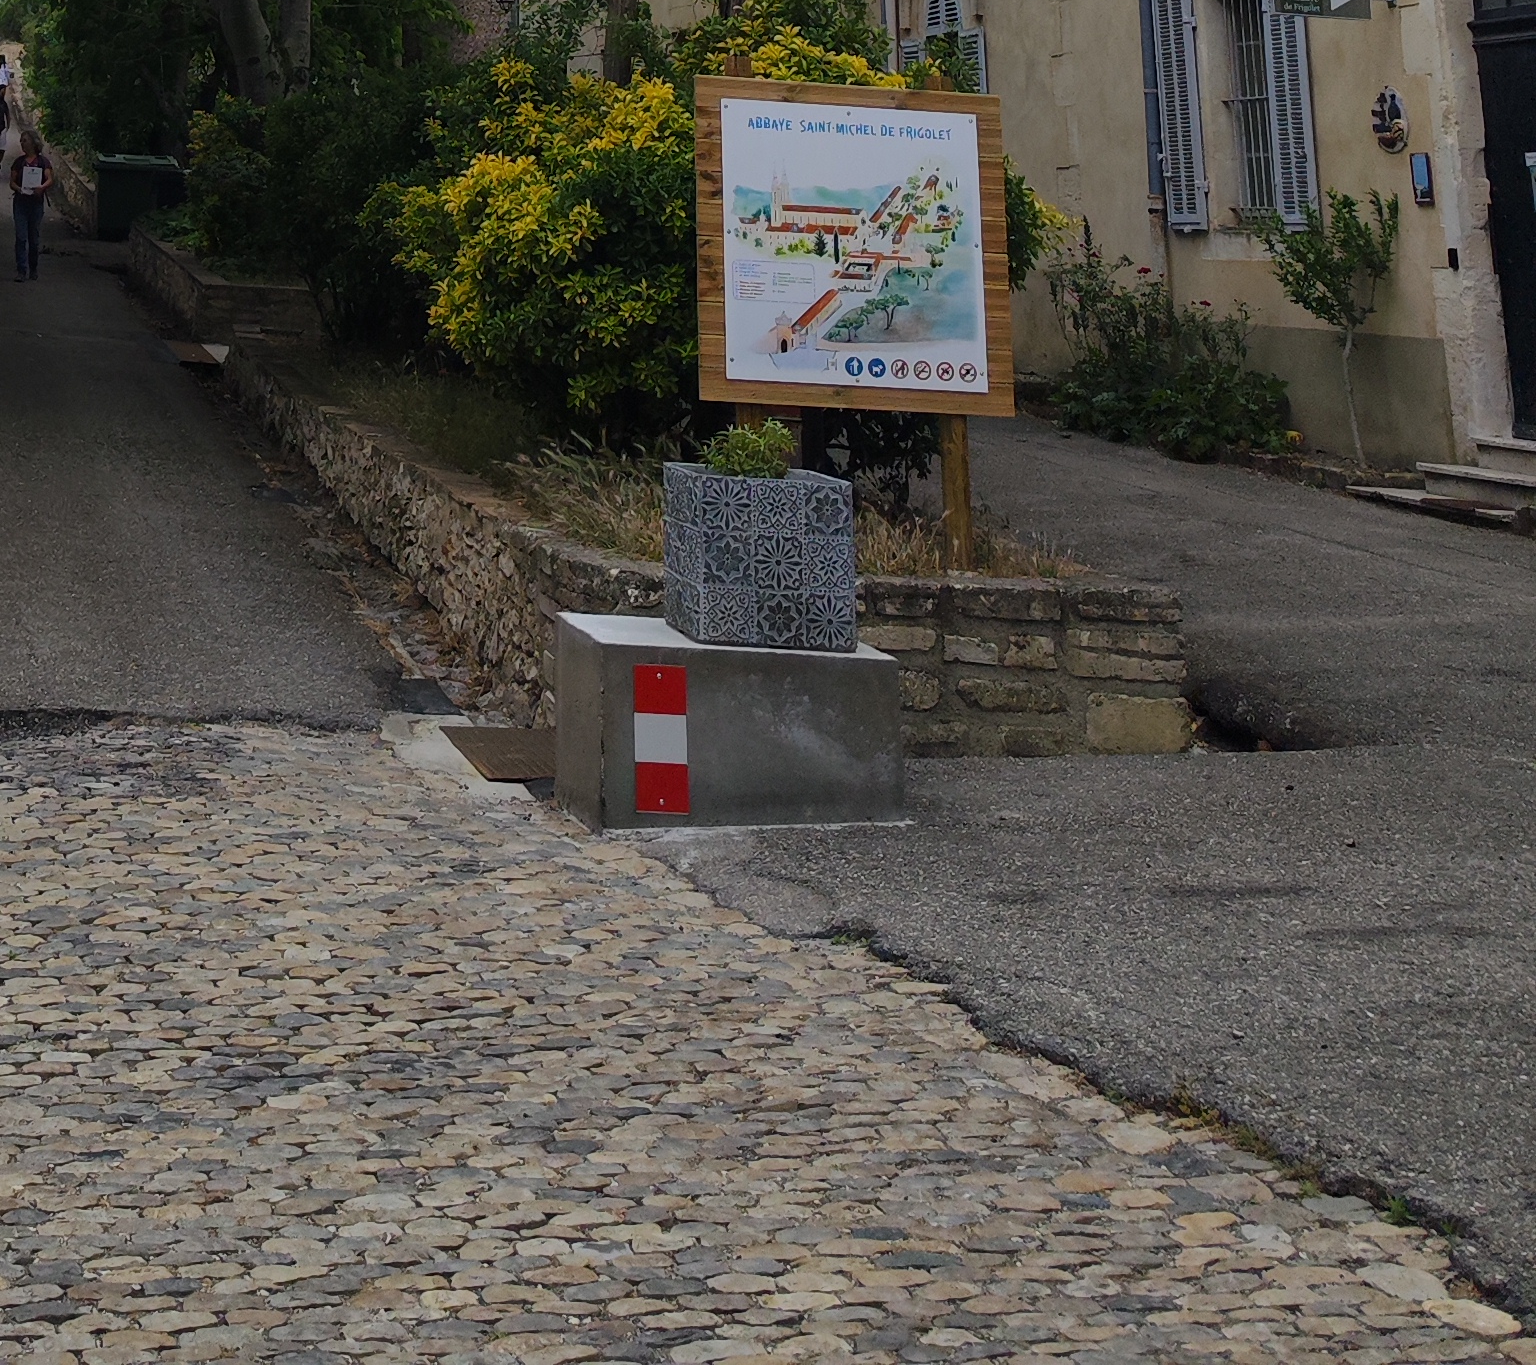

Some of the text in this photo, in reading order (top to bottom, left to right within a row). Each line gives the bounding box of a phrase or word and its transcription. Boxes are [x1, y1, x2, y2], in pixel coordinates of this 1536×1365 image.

[1283, 2, 1320, 12] de Frigolet
[748, 117, 793, 131] ABBAYE
[880, 124, 895, 137] DE
[899, 126, 952, 140] FRIGOLET
